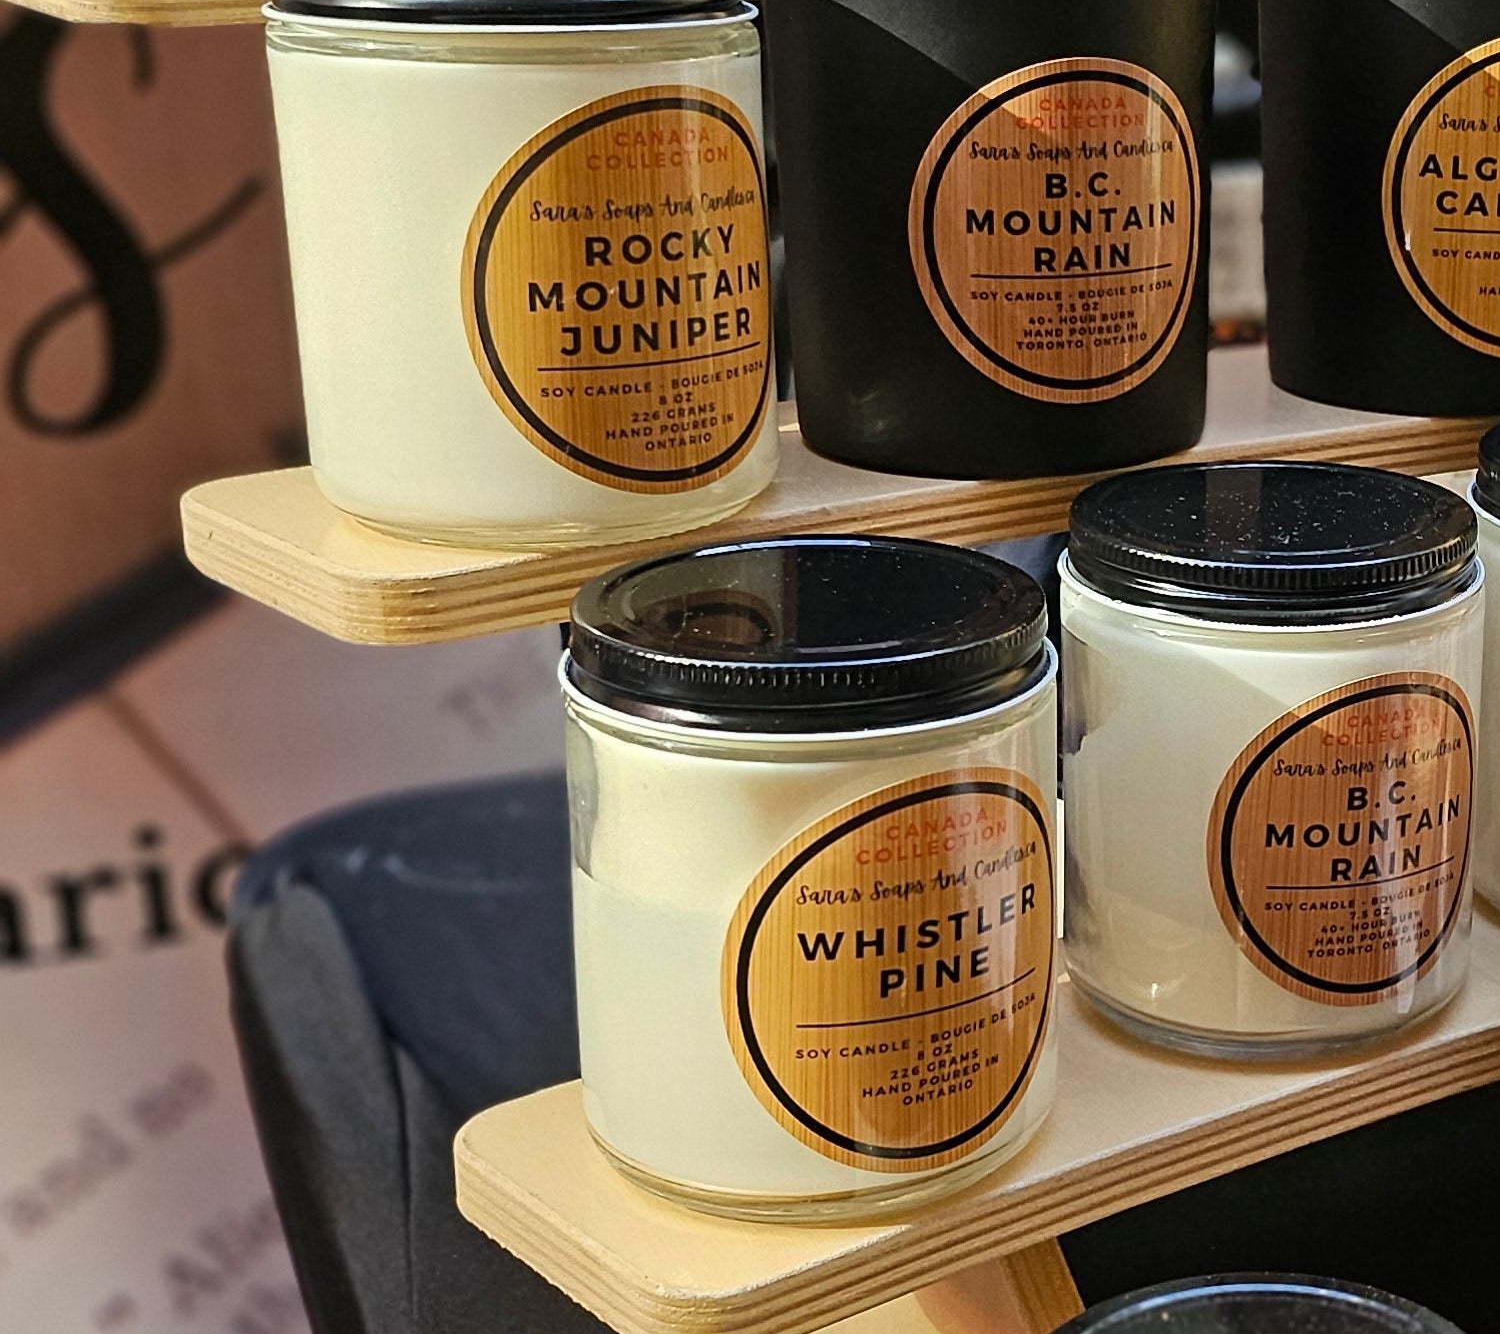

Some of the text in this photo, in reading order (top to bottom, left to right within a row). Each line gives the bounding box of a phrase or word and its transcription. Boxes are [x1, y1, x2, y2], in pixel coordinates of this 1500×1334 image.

[1039, 97, 1127, 111] CANADA
[1439, 113, 1487, 131] Sara's
[615, 128, 711, 148] CANADA
[586, 145, 728, 170] COLLECTION
[969, 141, 1108, 164] Sara's Soaps And
[1045, 171, 1121, 199] B.C.
[530, 194, 693, 223] Sara's Soaps And
[965, 199, 1176, 236] MOUNTAIN
[584, 223, 735, 266] ROCKY
[1033, 243, 1131, 273] RAIN
[1432, 248, 1459, 258] SOY
[528, 260, 761, 312] MOUNTAIN
[970, 290, 998, 301] SOY
[1004, 290, 1063, 302] CANDLE
[561, 307, 751, 356] JUNIPER
[1023, 323, 1122, 339] HAND POURED
[540, 385, 577, 397] SOY
[584, 381, 653, 396] CANDLE
[674, 391, 693, 404] OZ
[605, 417, 718, 440] HAND POURED
[645, 433, 712, 451] ONTARIO
[1273, 751, 1407, 777] Sara's Soaps And
[1346, 780, 1417, 811] B.C.
[886, 806, 989, 841] CANADA
[1264, 794, 1461, 849] MOUNTAIN
[855, 819, 1007, 866] COLLECTION
[1330, 845, 1421, 882] RAIN
[796, 869, 968, 906] Sara's Soaps And
[1264, 899, 1355, 911] SOY CANDLE
[797, 882, 1036, 961] WHISTLER
[1315, 934, 1355, 947] HAND
[879, 945, 990, 998] PINE
[795, 1009, 1006, 1059] SOY CANDLE BOUGIE DE
[931, 1043, 953, 1056] OZ
[862, 1053, 999, 1099] HAND POURED IN
[890, 1049, 979, 1081] 226 GRAMS
[902, 1079, 974, 1107] ONTARIO
